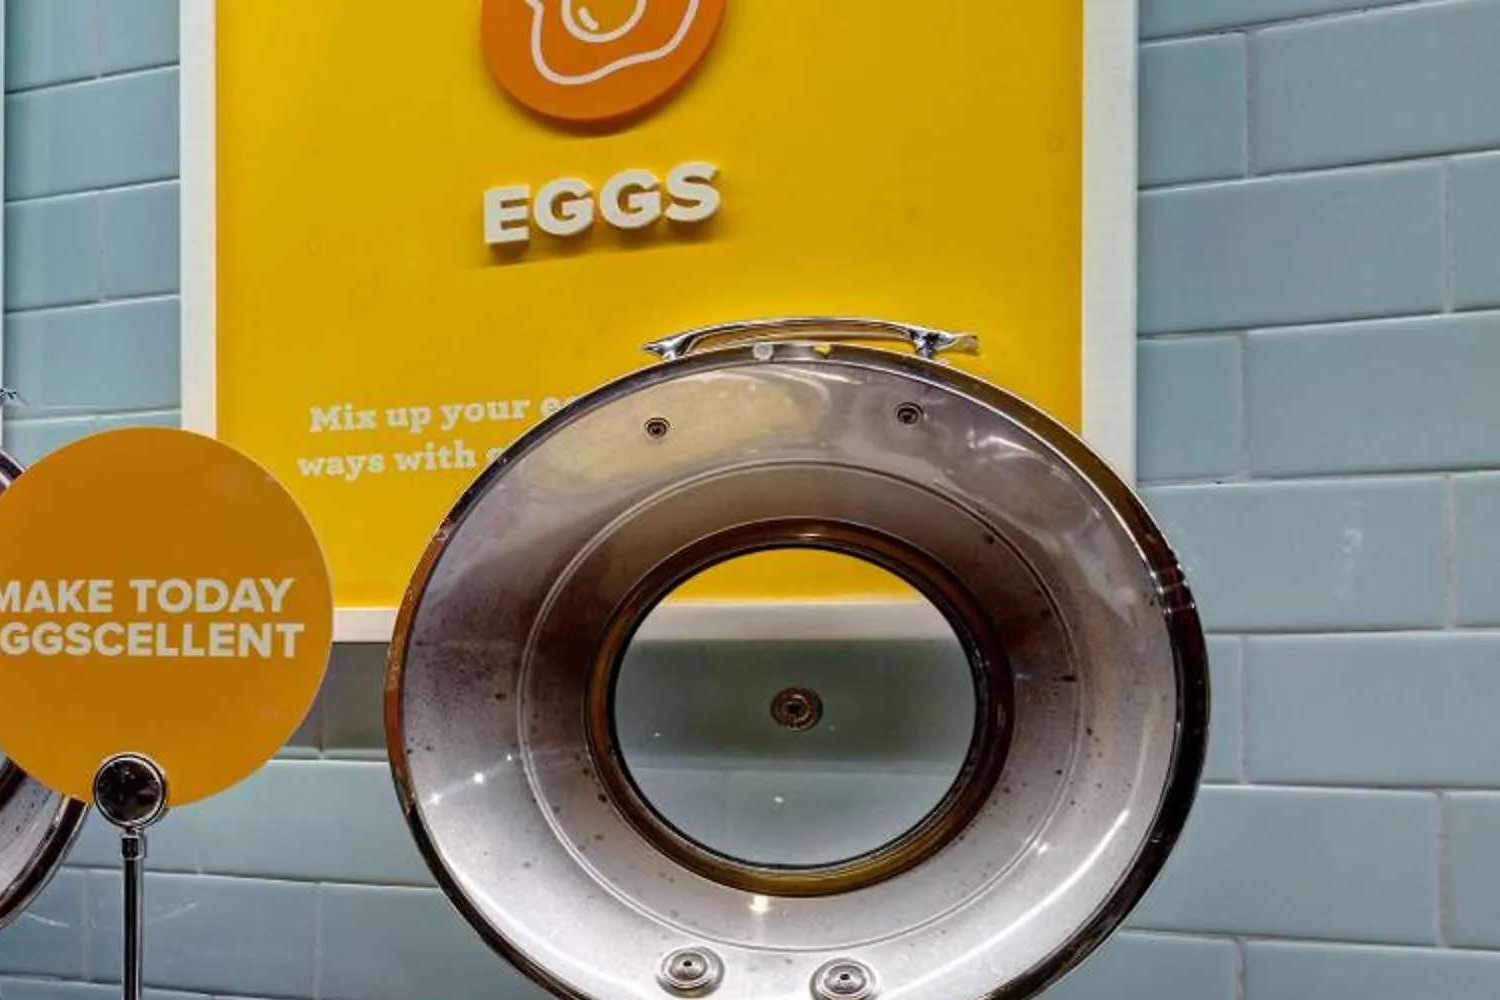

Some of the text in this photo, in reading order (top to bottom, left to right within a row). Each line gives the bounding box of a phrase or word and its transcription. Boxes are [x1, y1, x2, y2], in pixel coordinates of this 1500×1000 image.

[484, 162, 720, 244] EGGS
[309, 404, 377, 433] Mix
[387, 405, 432, 434] up
[440, 398, 531, 430] your
[297, 450, 385, 481] ways
[394, 441, 476, 472] with
[130, 577, 295, 614] TODAY
